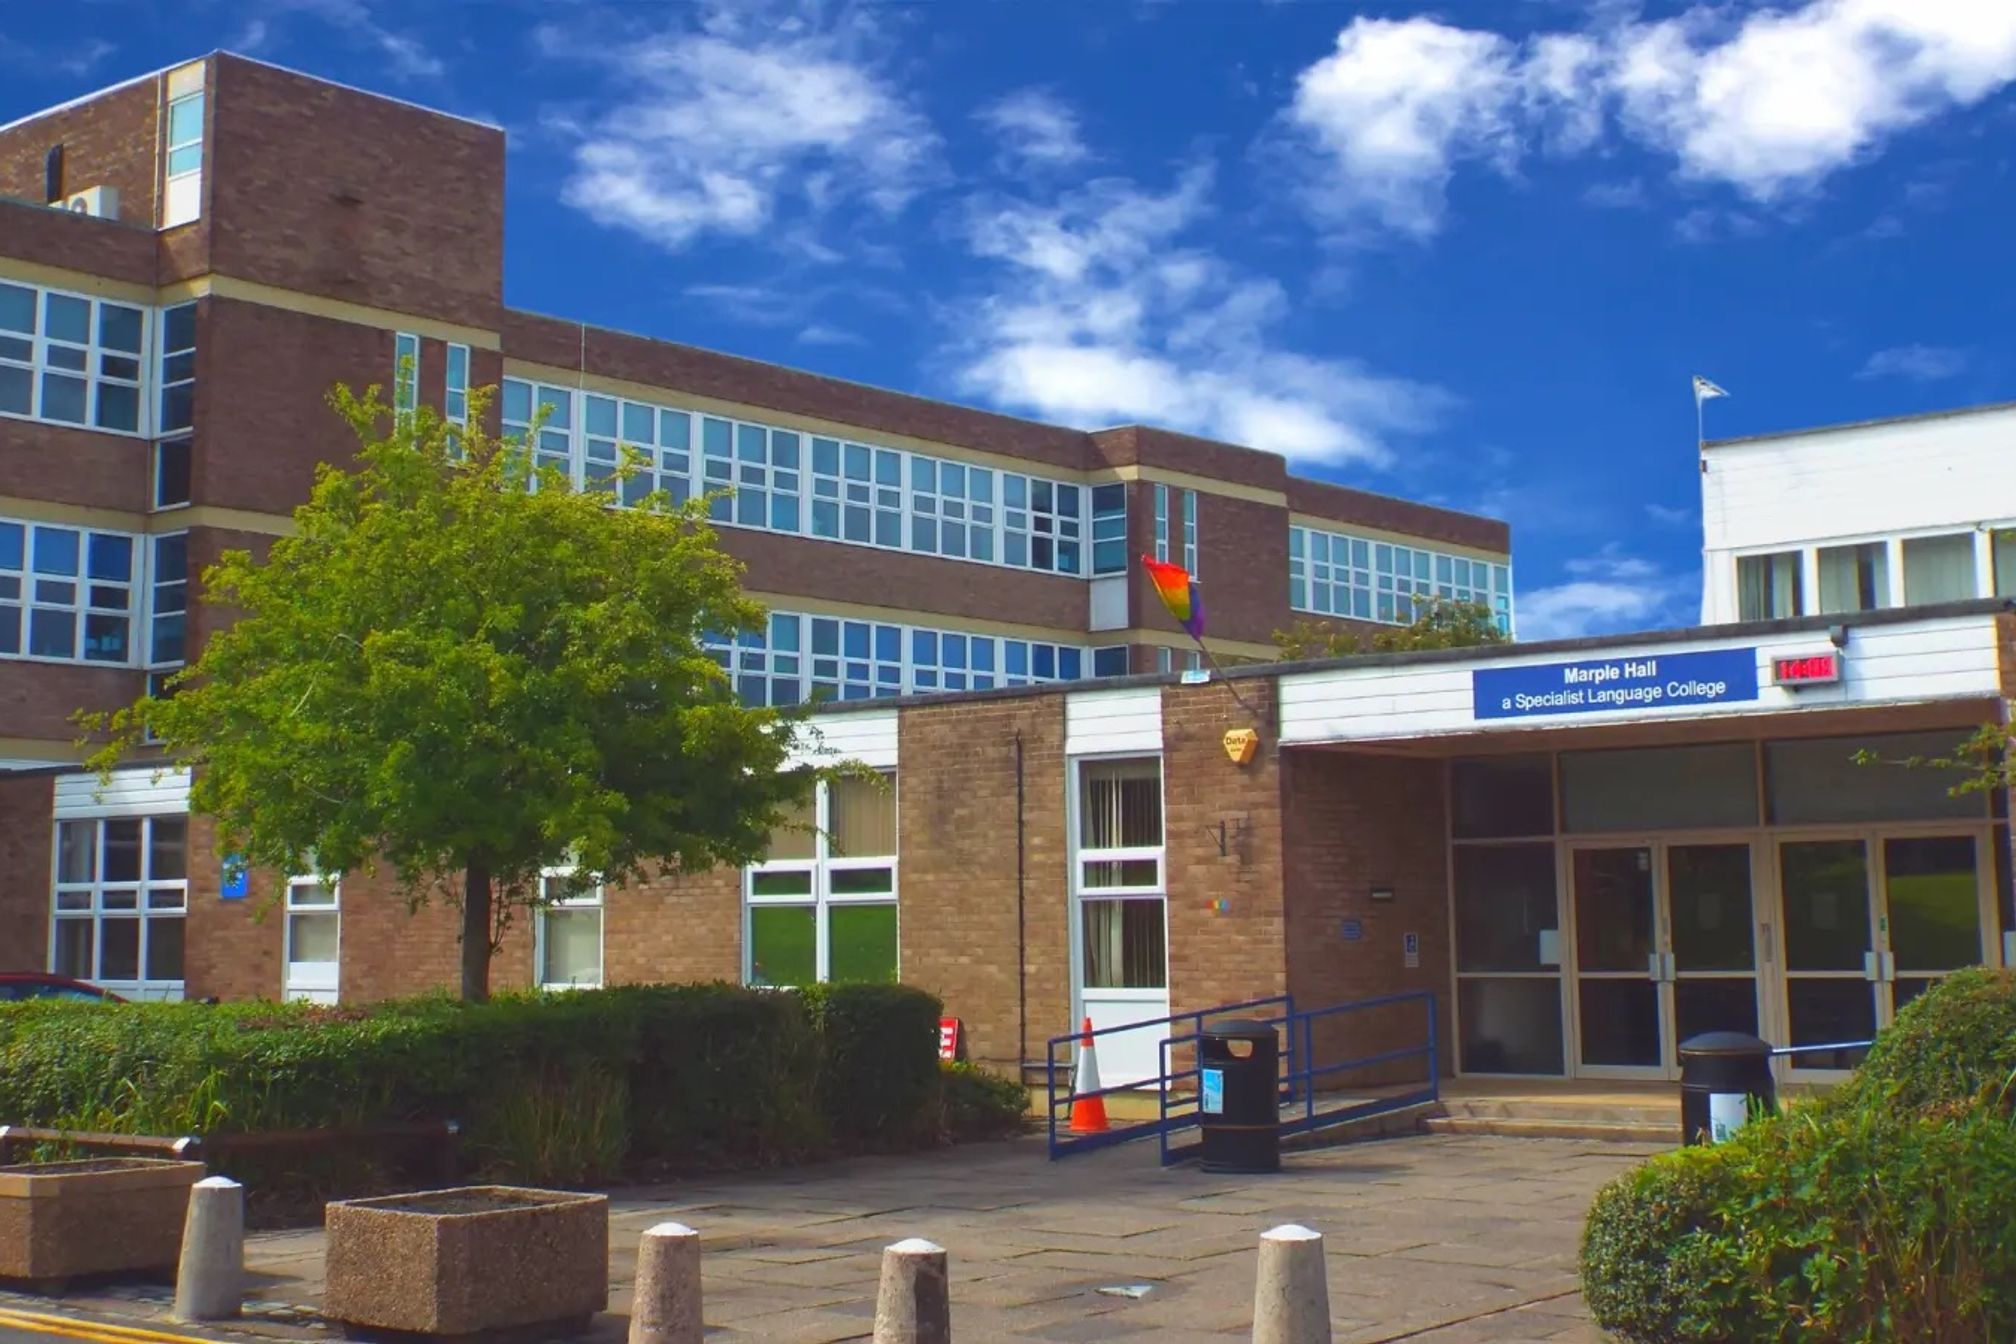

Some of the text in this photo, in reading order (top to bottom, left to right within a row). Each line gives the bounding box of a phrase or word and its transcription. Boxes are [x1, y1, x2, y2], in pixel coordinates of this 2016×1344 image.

[1564, 660, 1656, 684] Marple Hall
[1502, 680, 1726, 711] a Specialist Language College
